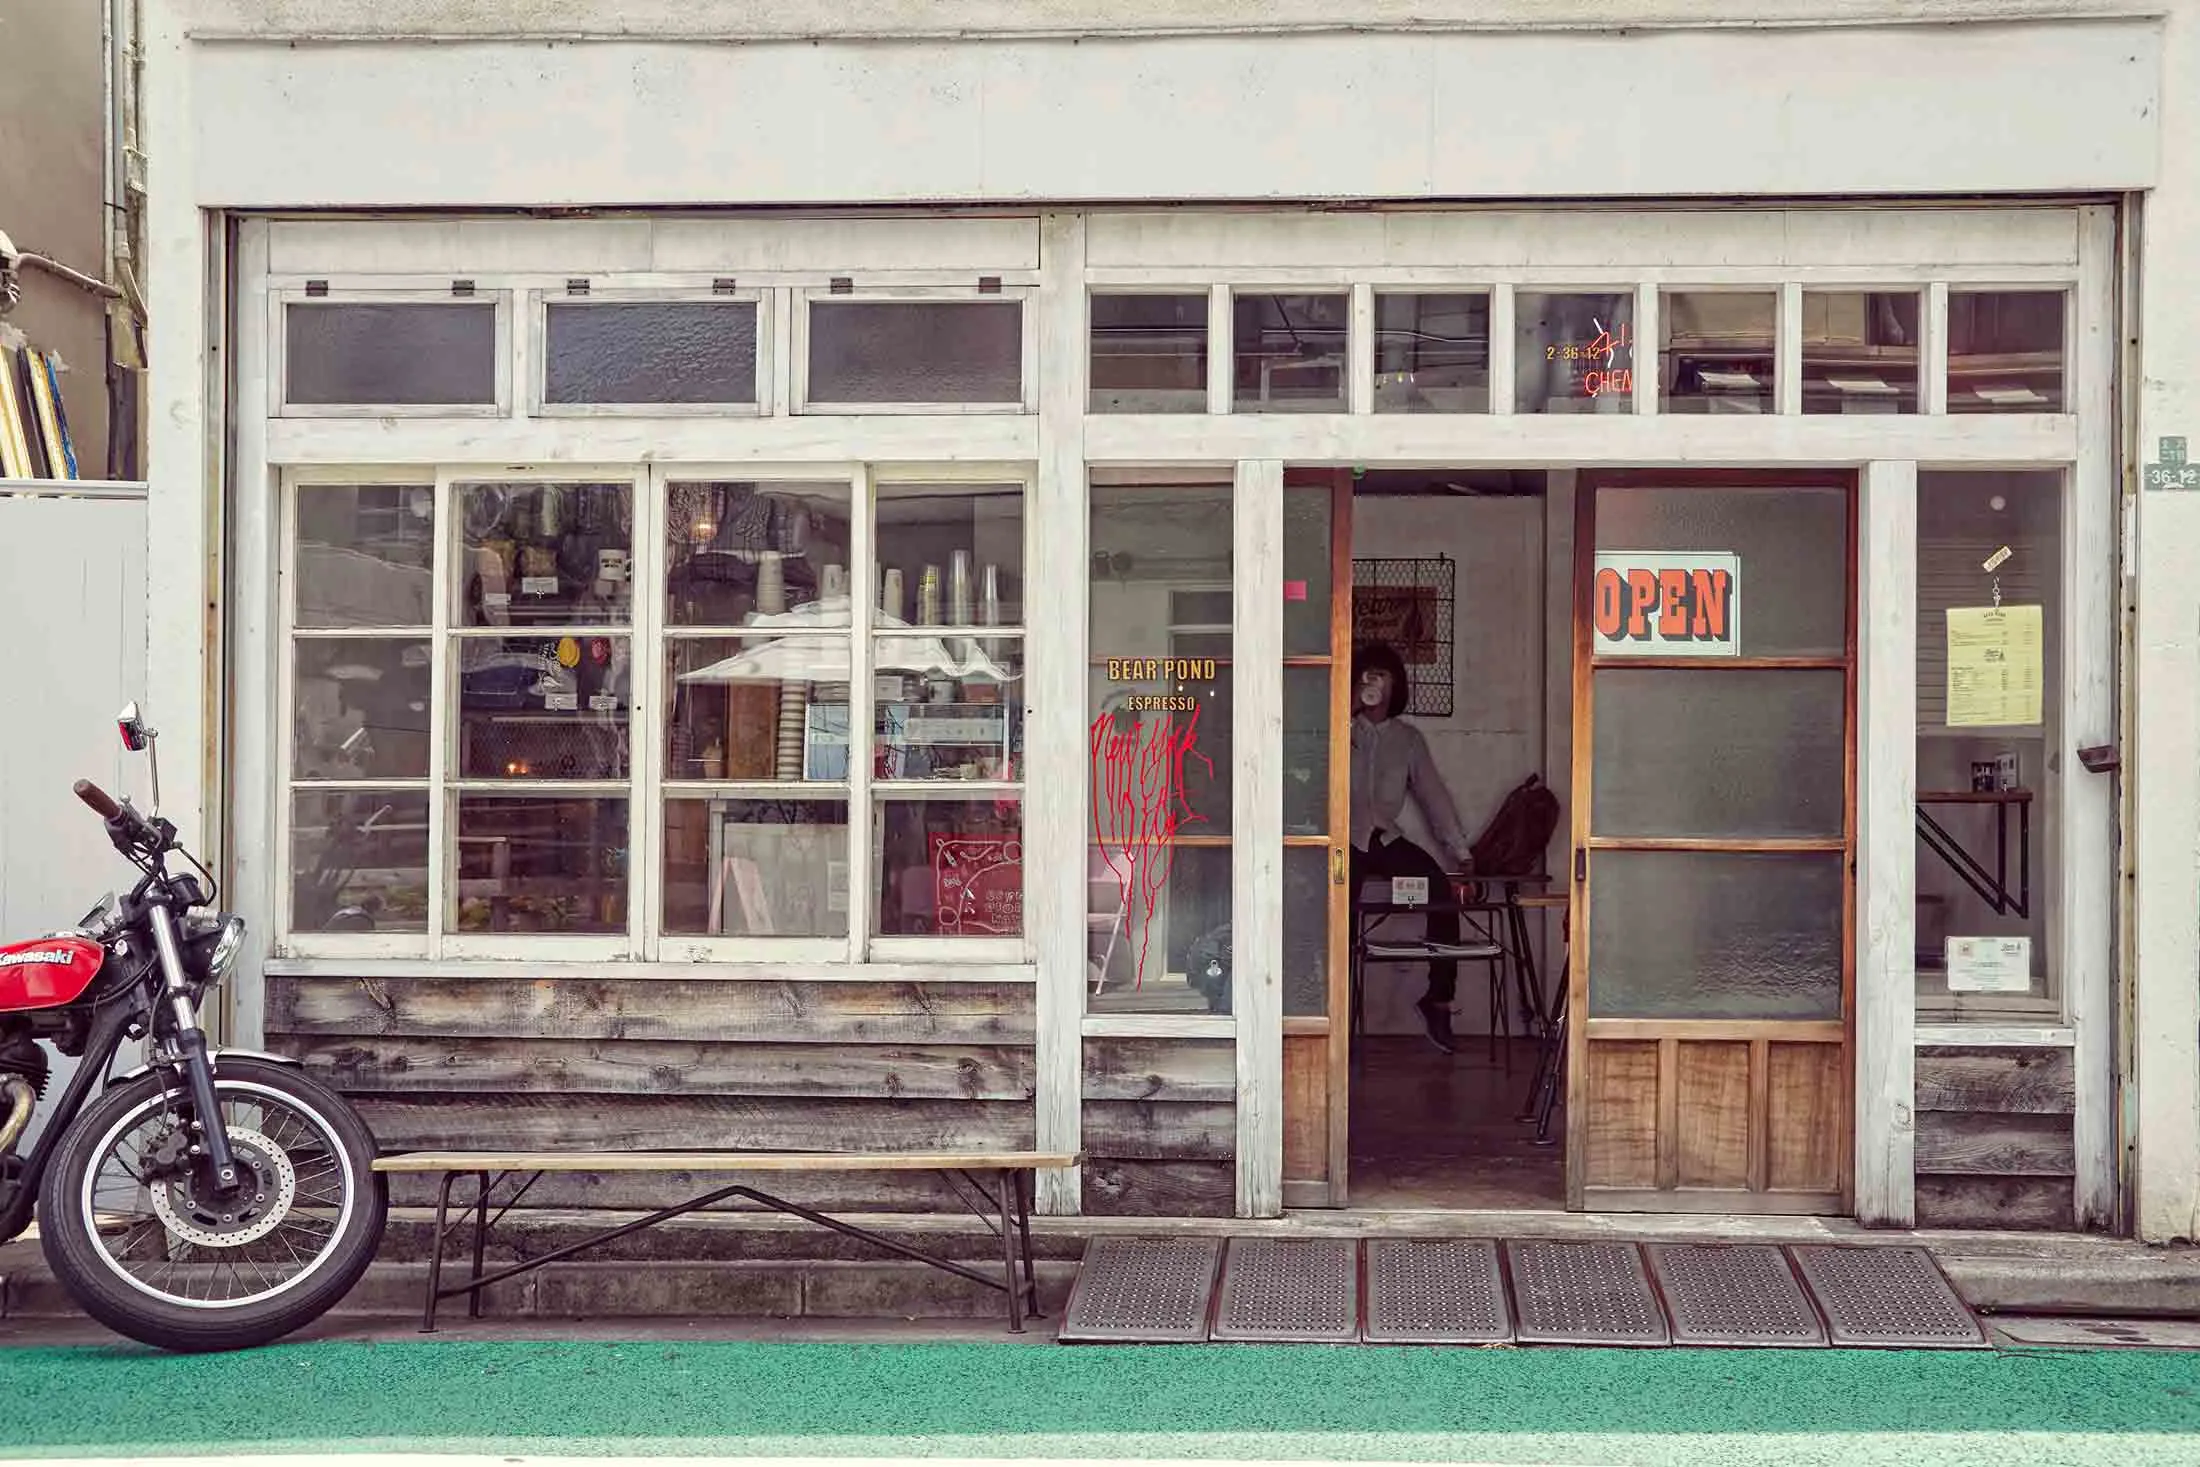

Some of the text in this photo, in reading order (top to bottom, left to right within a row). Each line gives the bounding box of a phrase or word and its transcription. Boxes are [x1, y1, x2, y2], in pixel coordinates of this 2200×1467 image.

[2152, 470, 2196, 484] 36-12
[1595, 567, 1733, 642] OPEN
[1107, 658, 1217, 681] BEAR POND
[1128, 696, 1196, 711] ESPRESSO
